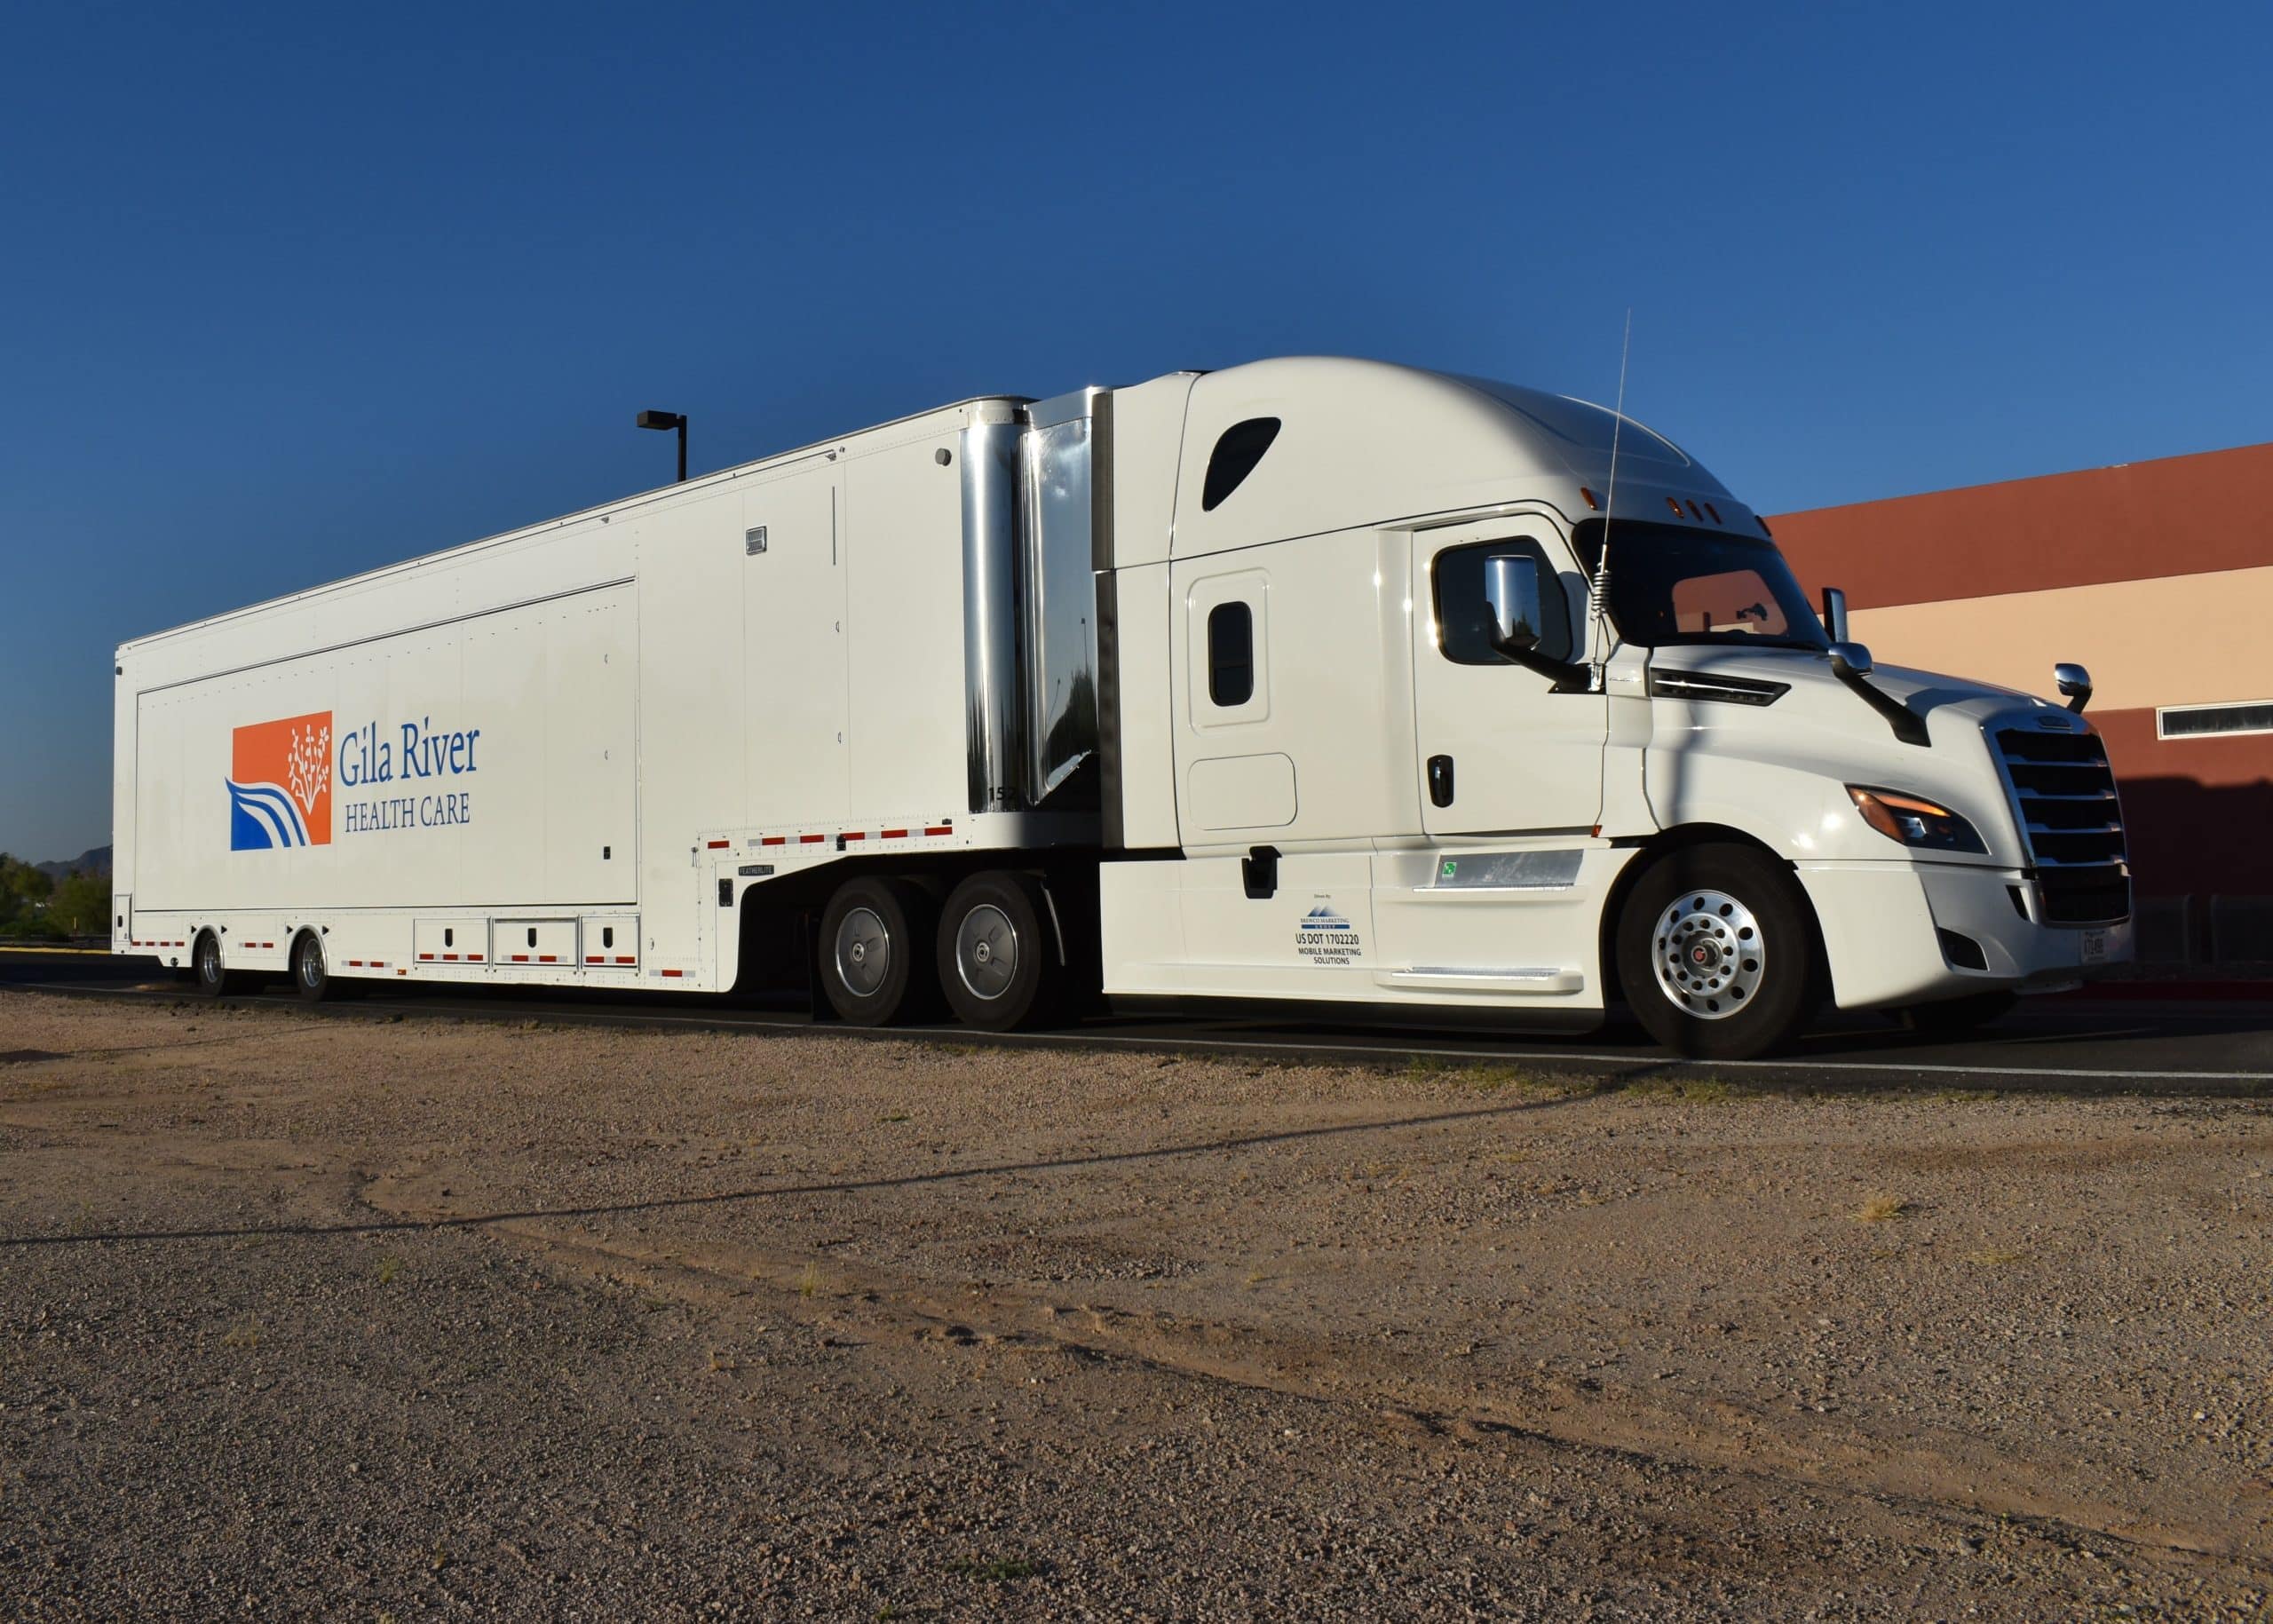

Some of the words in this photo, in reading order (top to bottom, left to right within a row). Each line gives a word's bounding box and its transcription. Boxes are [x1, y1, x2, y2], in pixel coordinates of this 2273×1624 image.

[339, 720, 393, 787] Gila
[400, 716, 480, 779] River
[345, 797, 416, 832] HEALTH
[420, 793, 471, 827] CARE
[1295, 933, 1306, 945] US
[1307, 933, 1323, 945] DOT
[1326, 934, 1359, 945] 1702220
[1323, 947, 1361, 956] MARKETING
